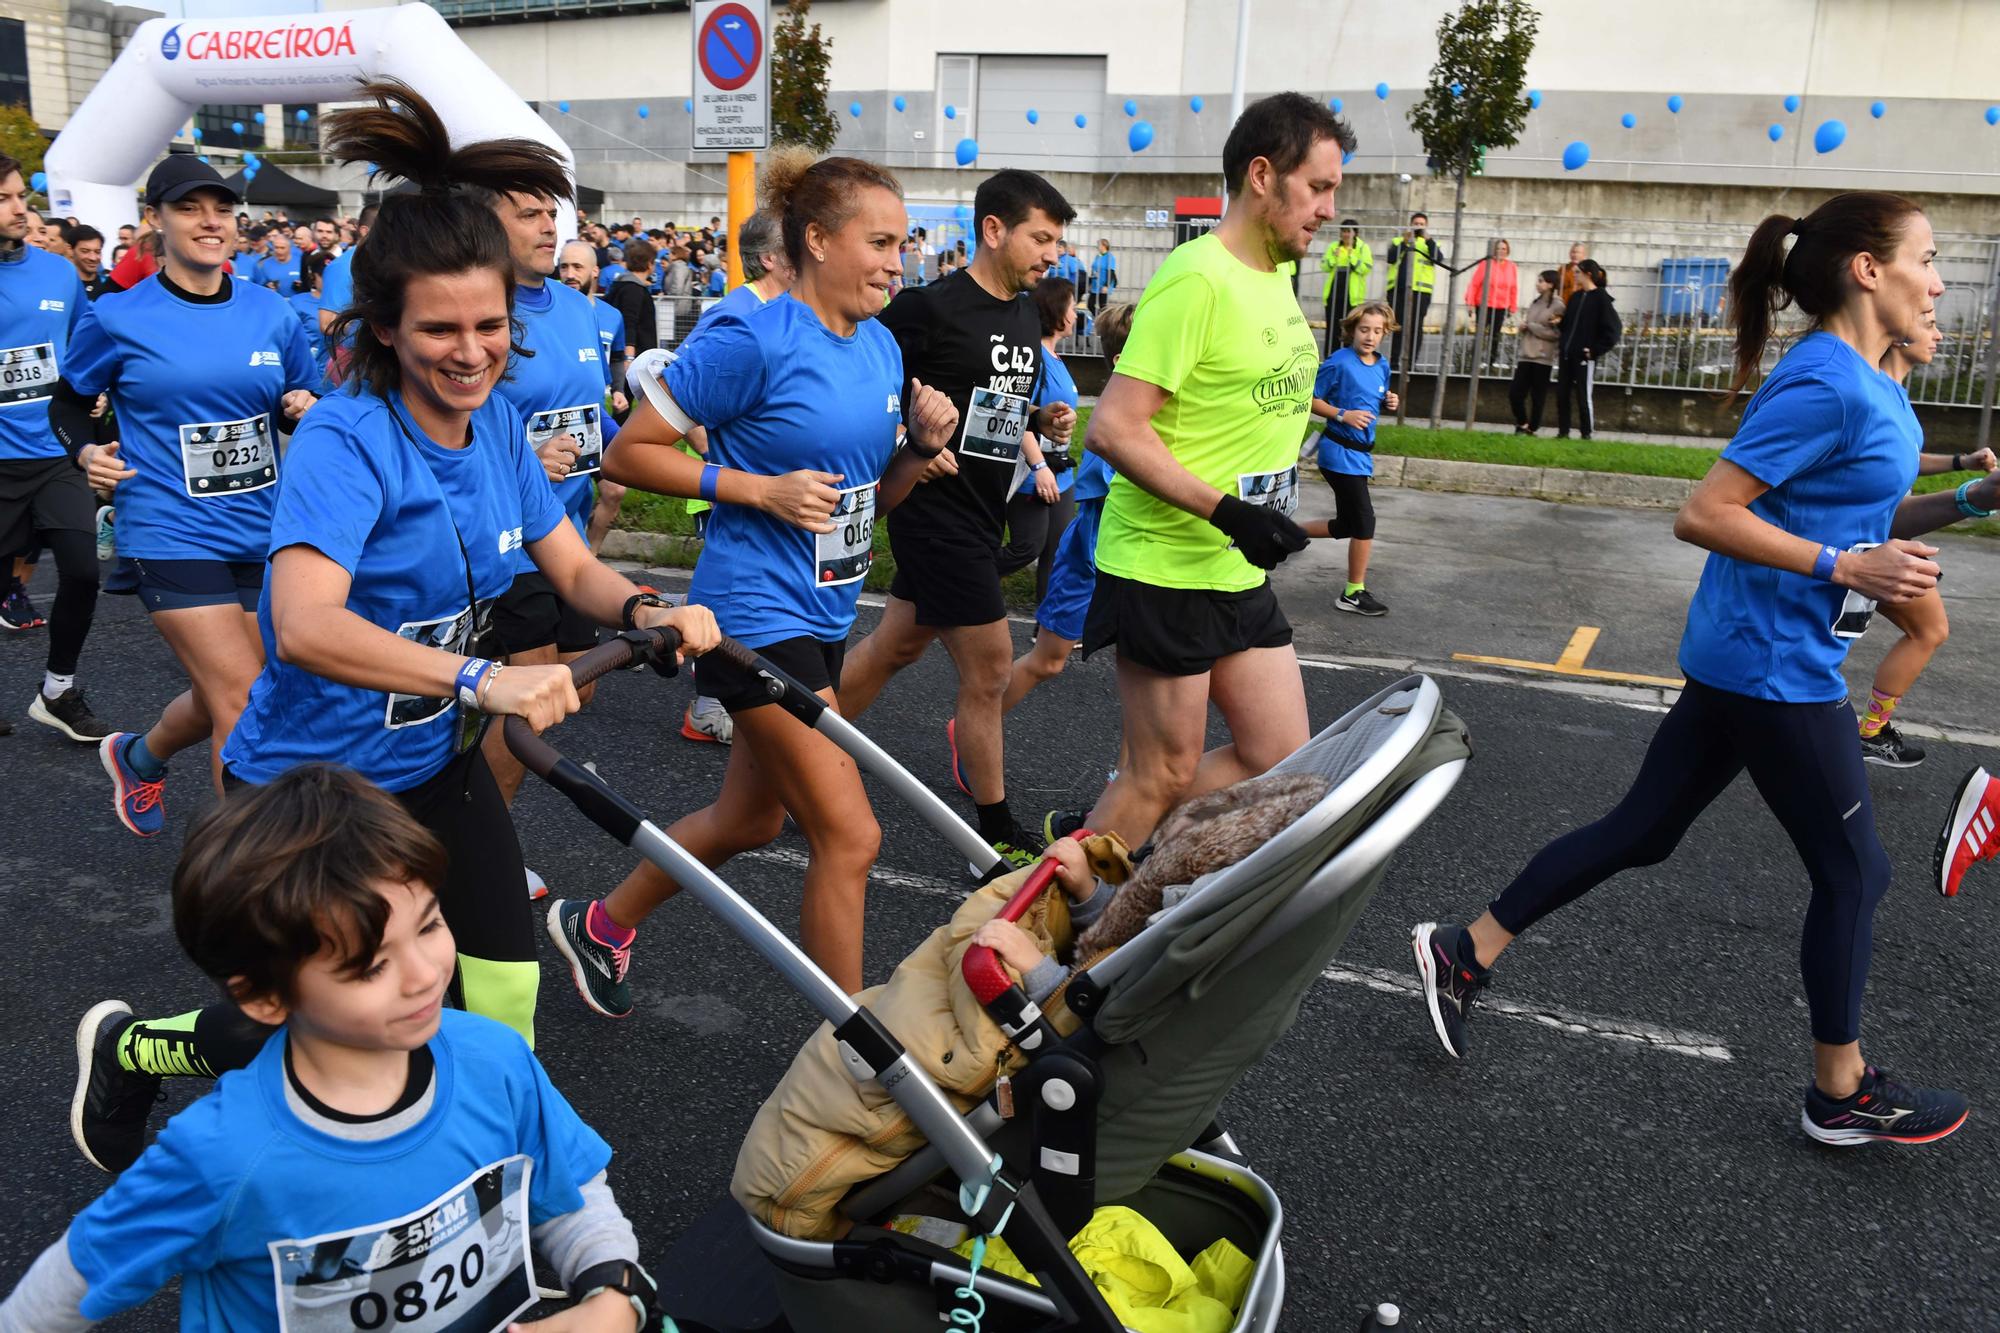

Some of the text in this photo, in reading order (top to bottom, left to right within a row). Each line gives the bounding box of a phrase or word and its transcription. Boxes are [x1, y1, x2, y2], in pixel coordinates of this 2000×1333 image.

[3, 366, 42, 384] 0318
[987, 416, 1019, 437] 0706
[212, 445, 260, 468] 0232
[407, 1195, 468, 1246] 5KM
[407, 1216, 469, 1258] SOLIDARIOS
[350, 1243, 485, 1331] 0820
